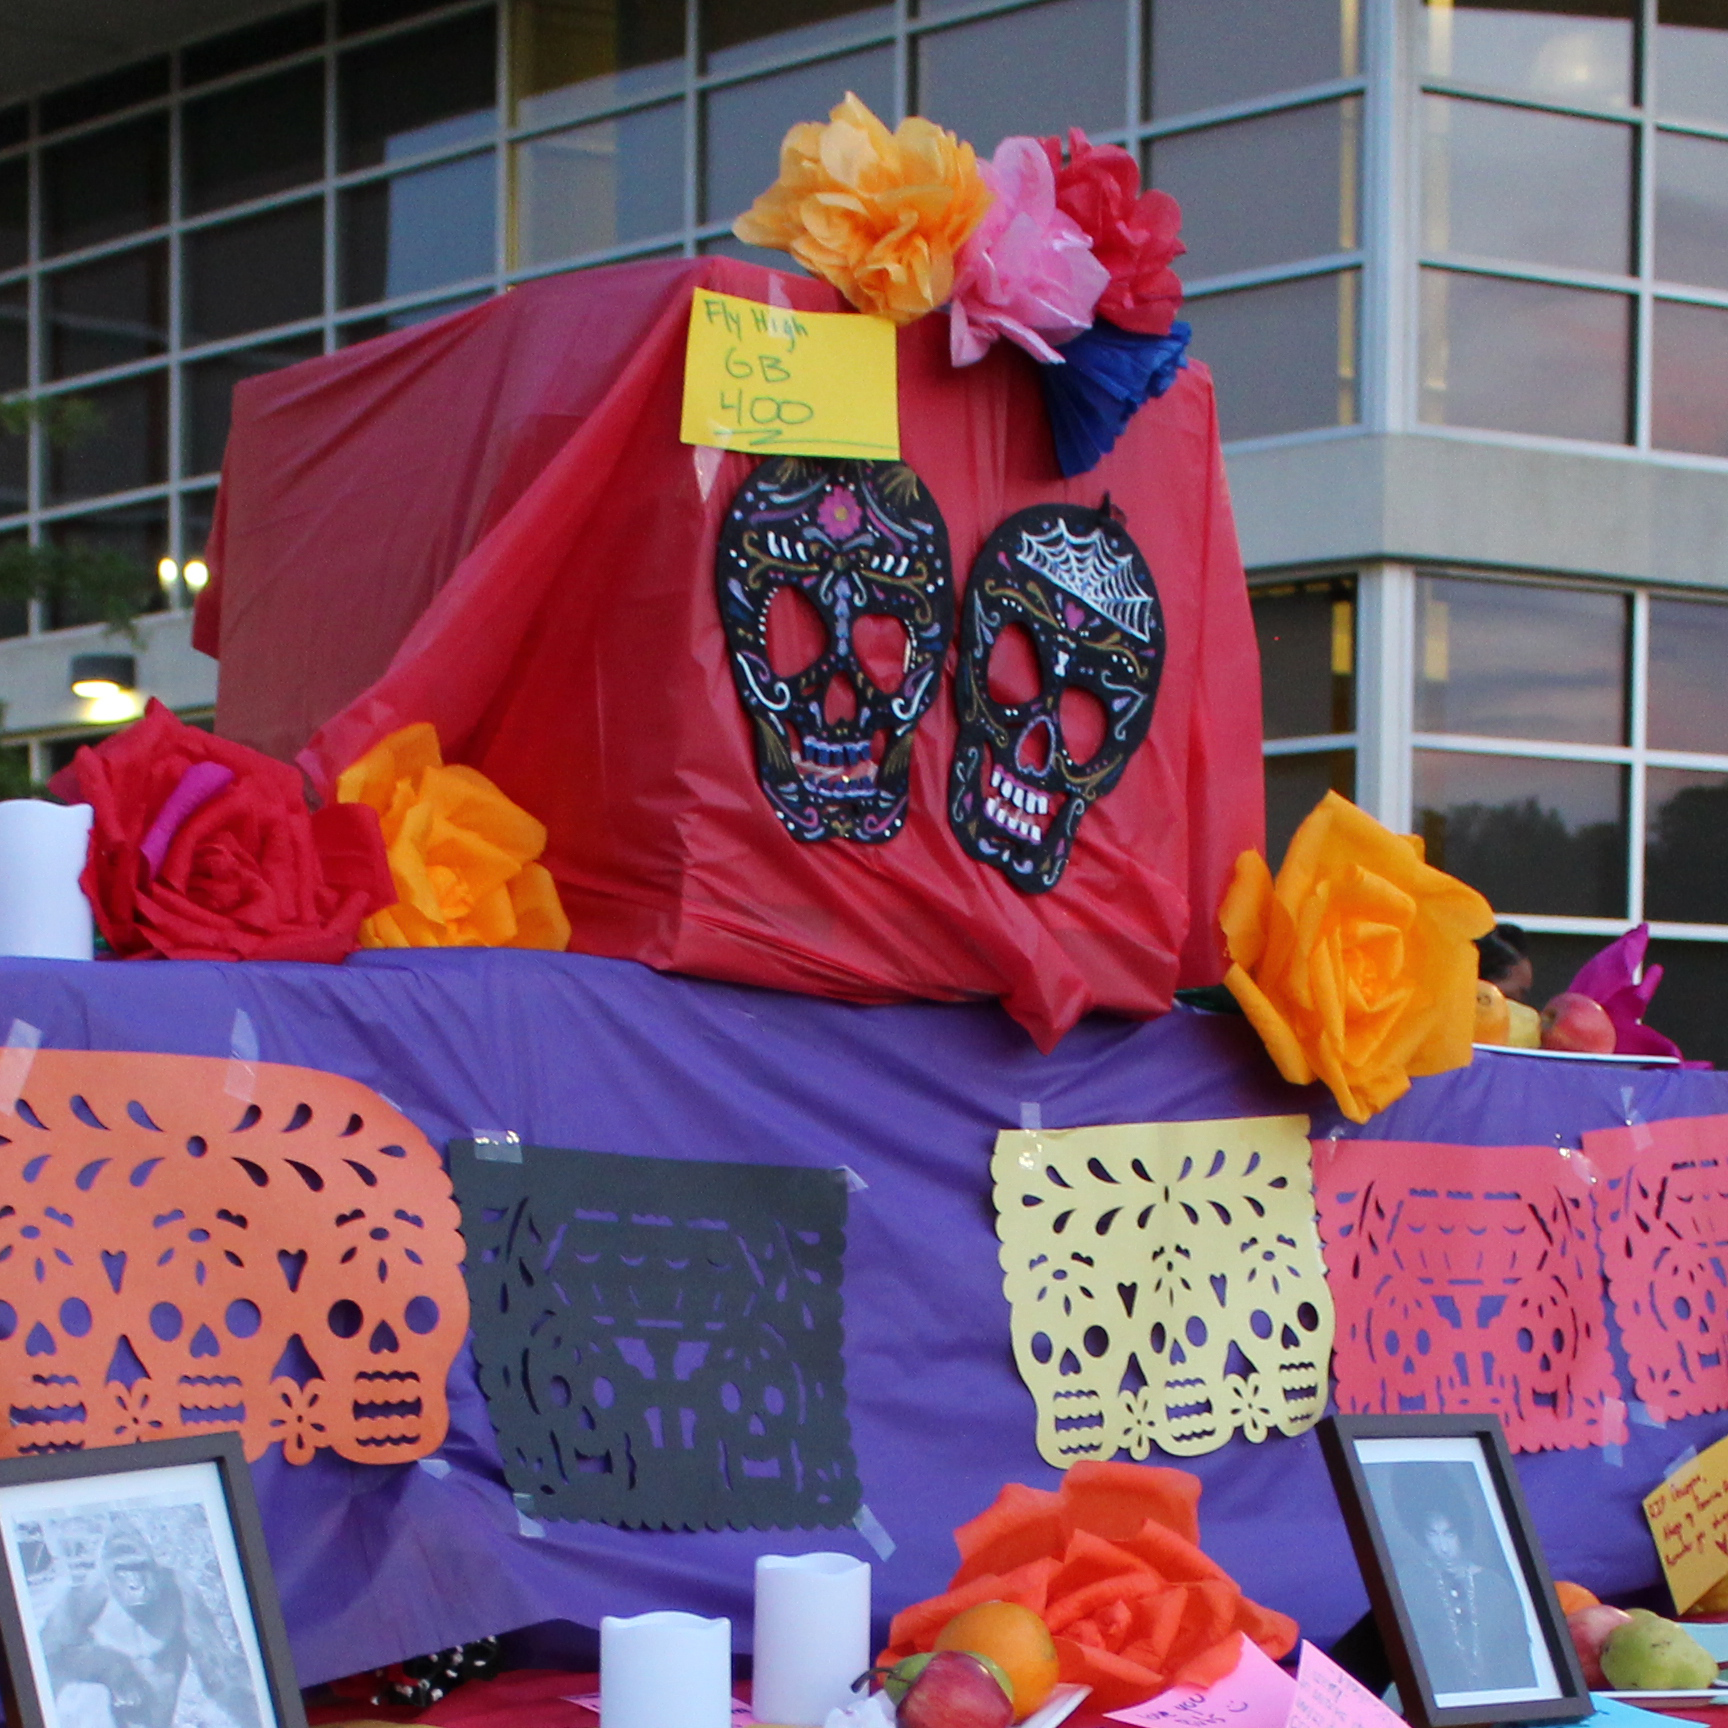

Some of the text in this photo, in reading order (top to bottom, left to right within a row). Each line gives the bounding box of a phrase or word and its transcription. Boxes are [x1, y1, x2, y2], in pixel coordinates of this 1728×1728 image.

[704, 299, 809, 353] Fly High
[725, 347, 791, 383] GB
[720, 387, 814, 426] 400
